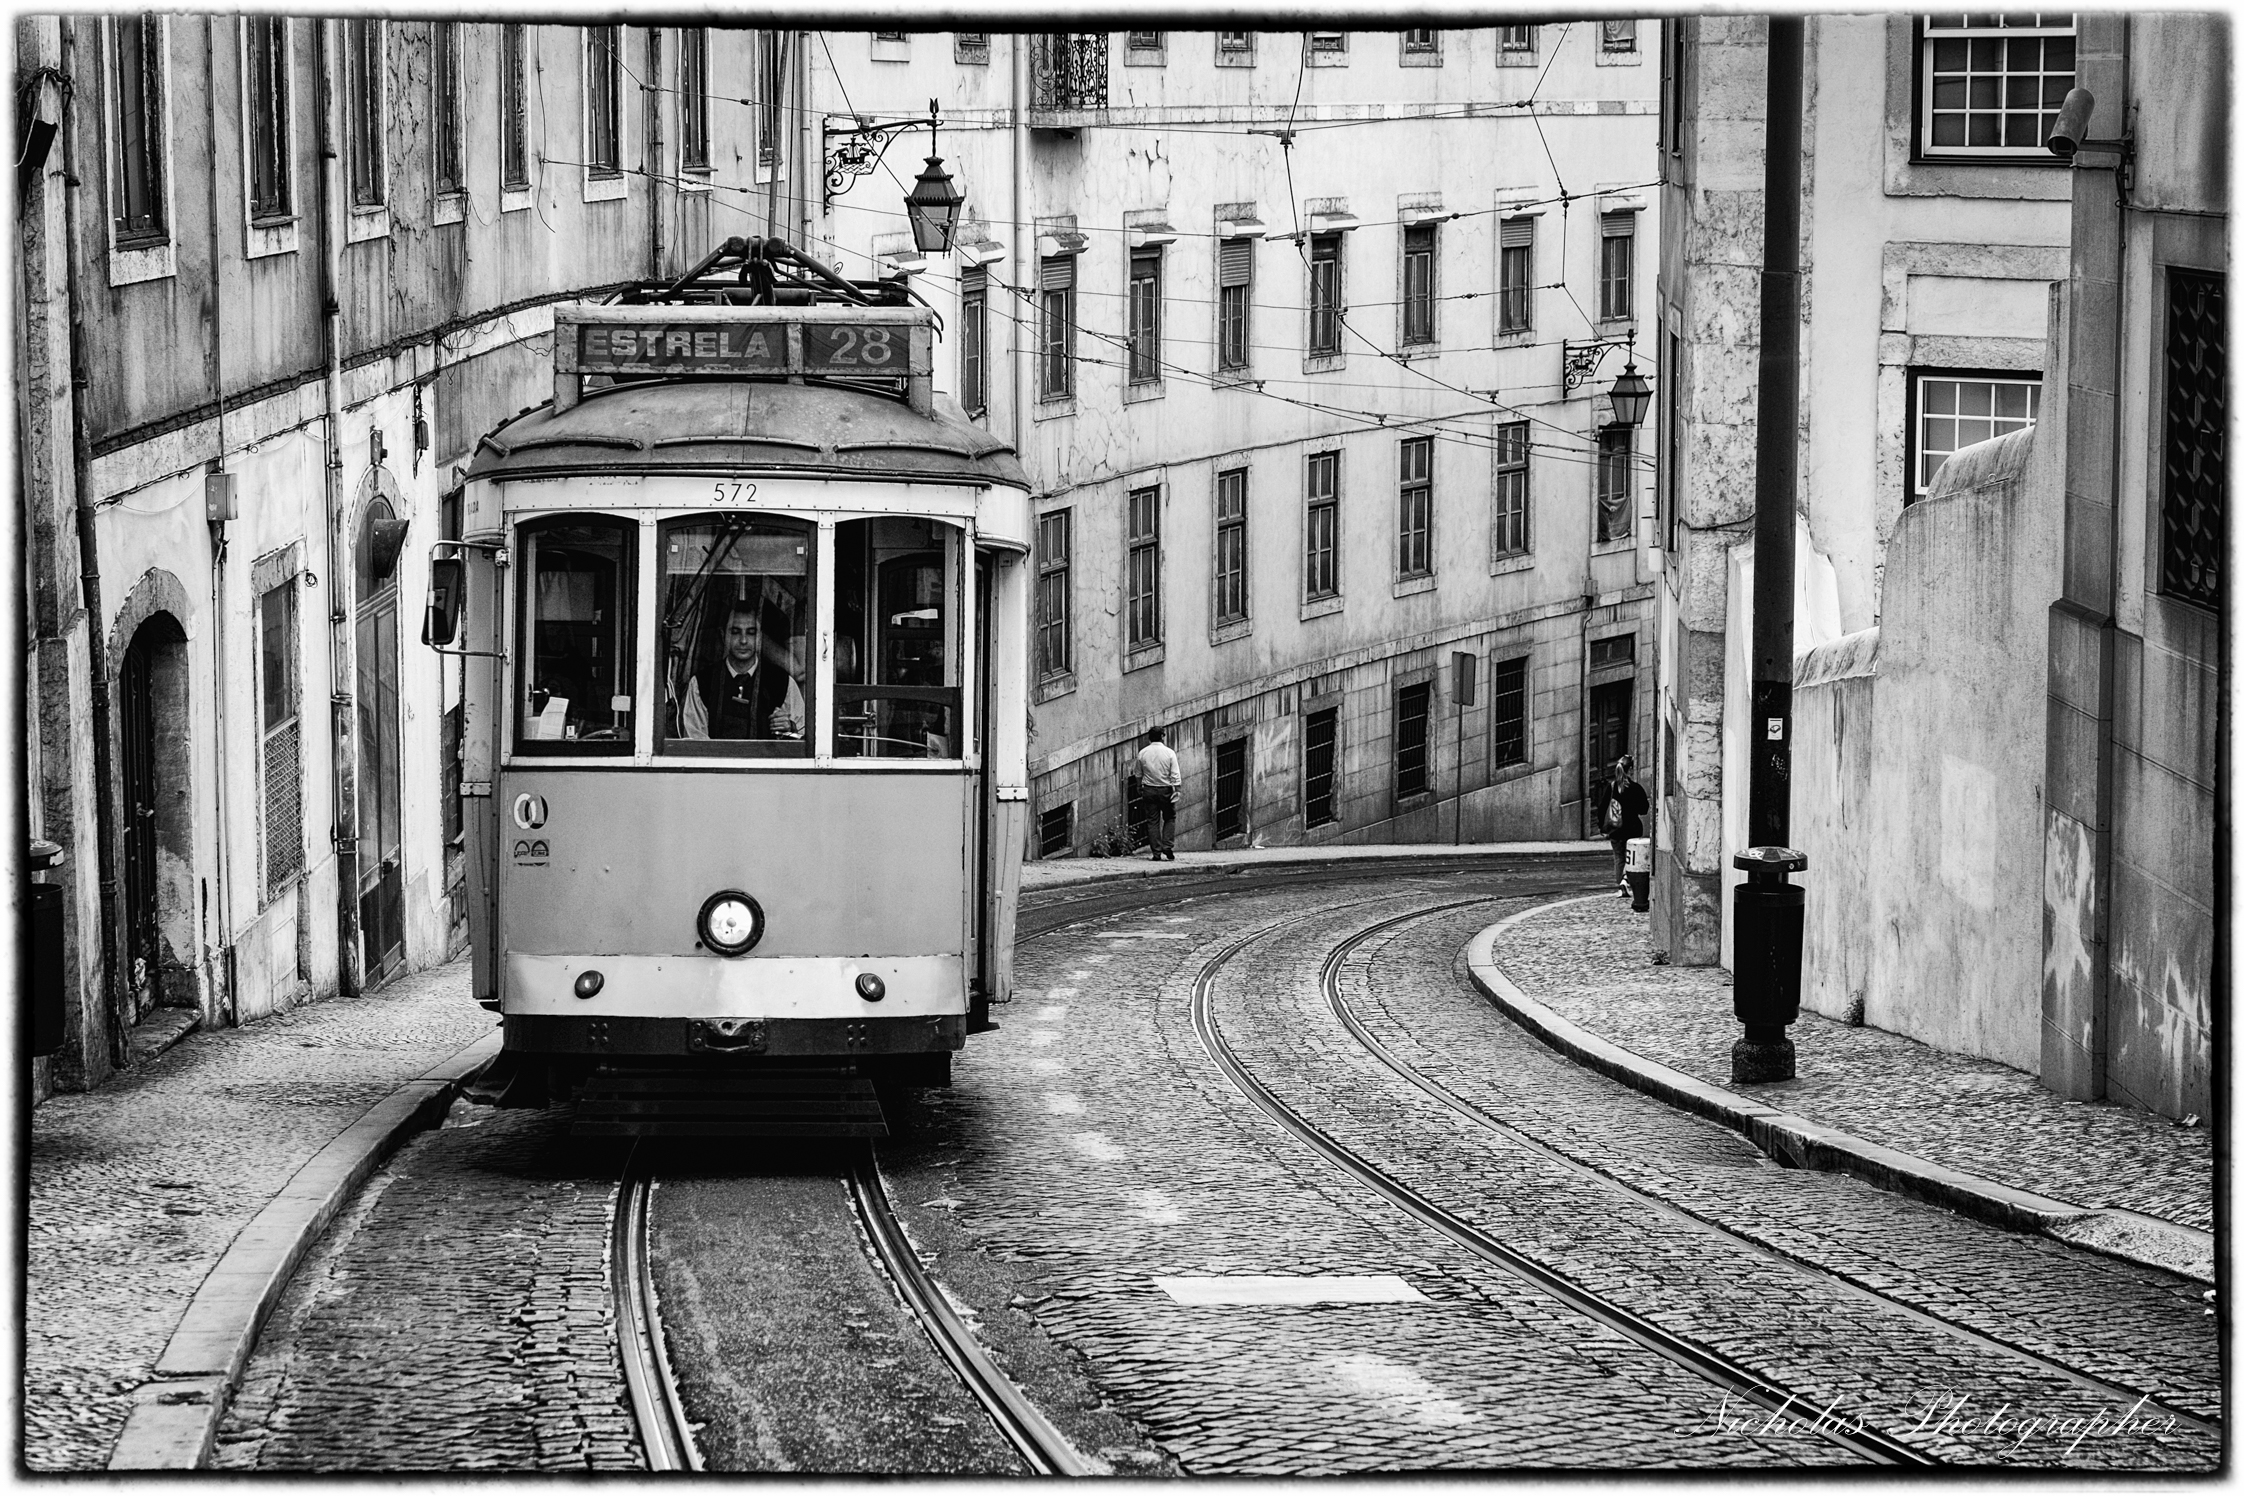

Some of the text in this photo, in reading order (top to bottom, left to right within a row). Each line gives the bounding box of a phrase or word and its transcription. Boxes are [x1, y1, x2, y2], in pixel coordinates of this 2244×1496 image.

[585, 329, 771, 358] ESTRELA
[829, 325, 892, 365] 28
[713, 483, 758, 502] 572
